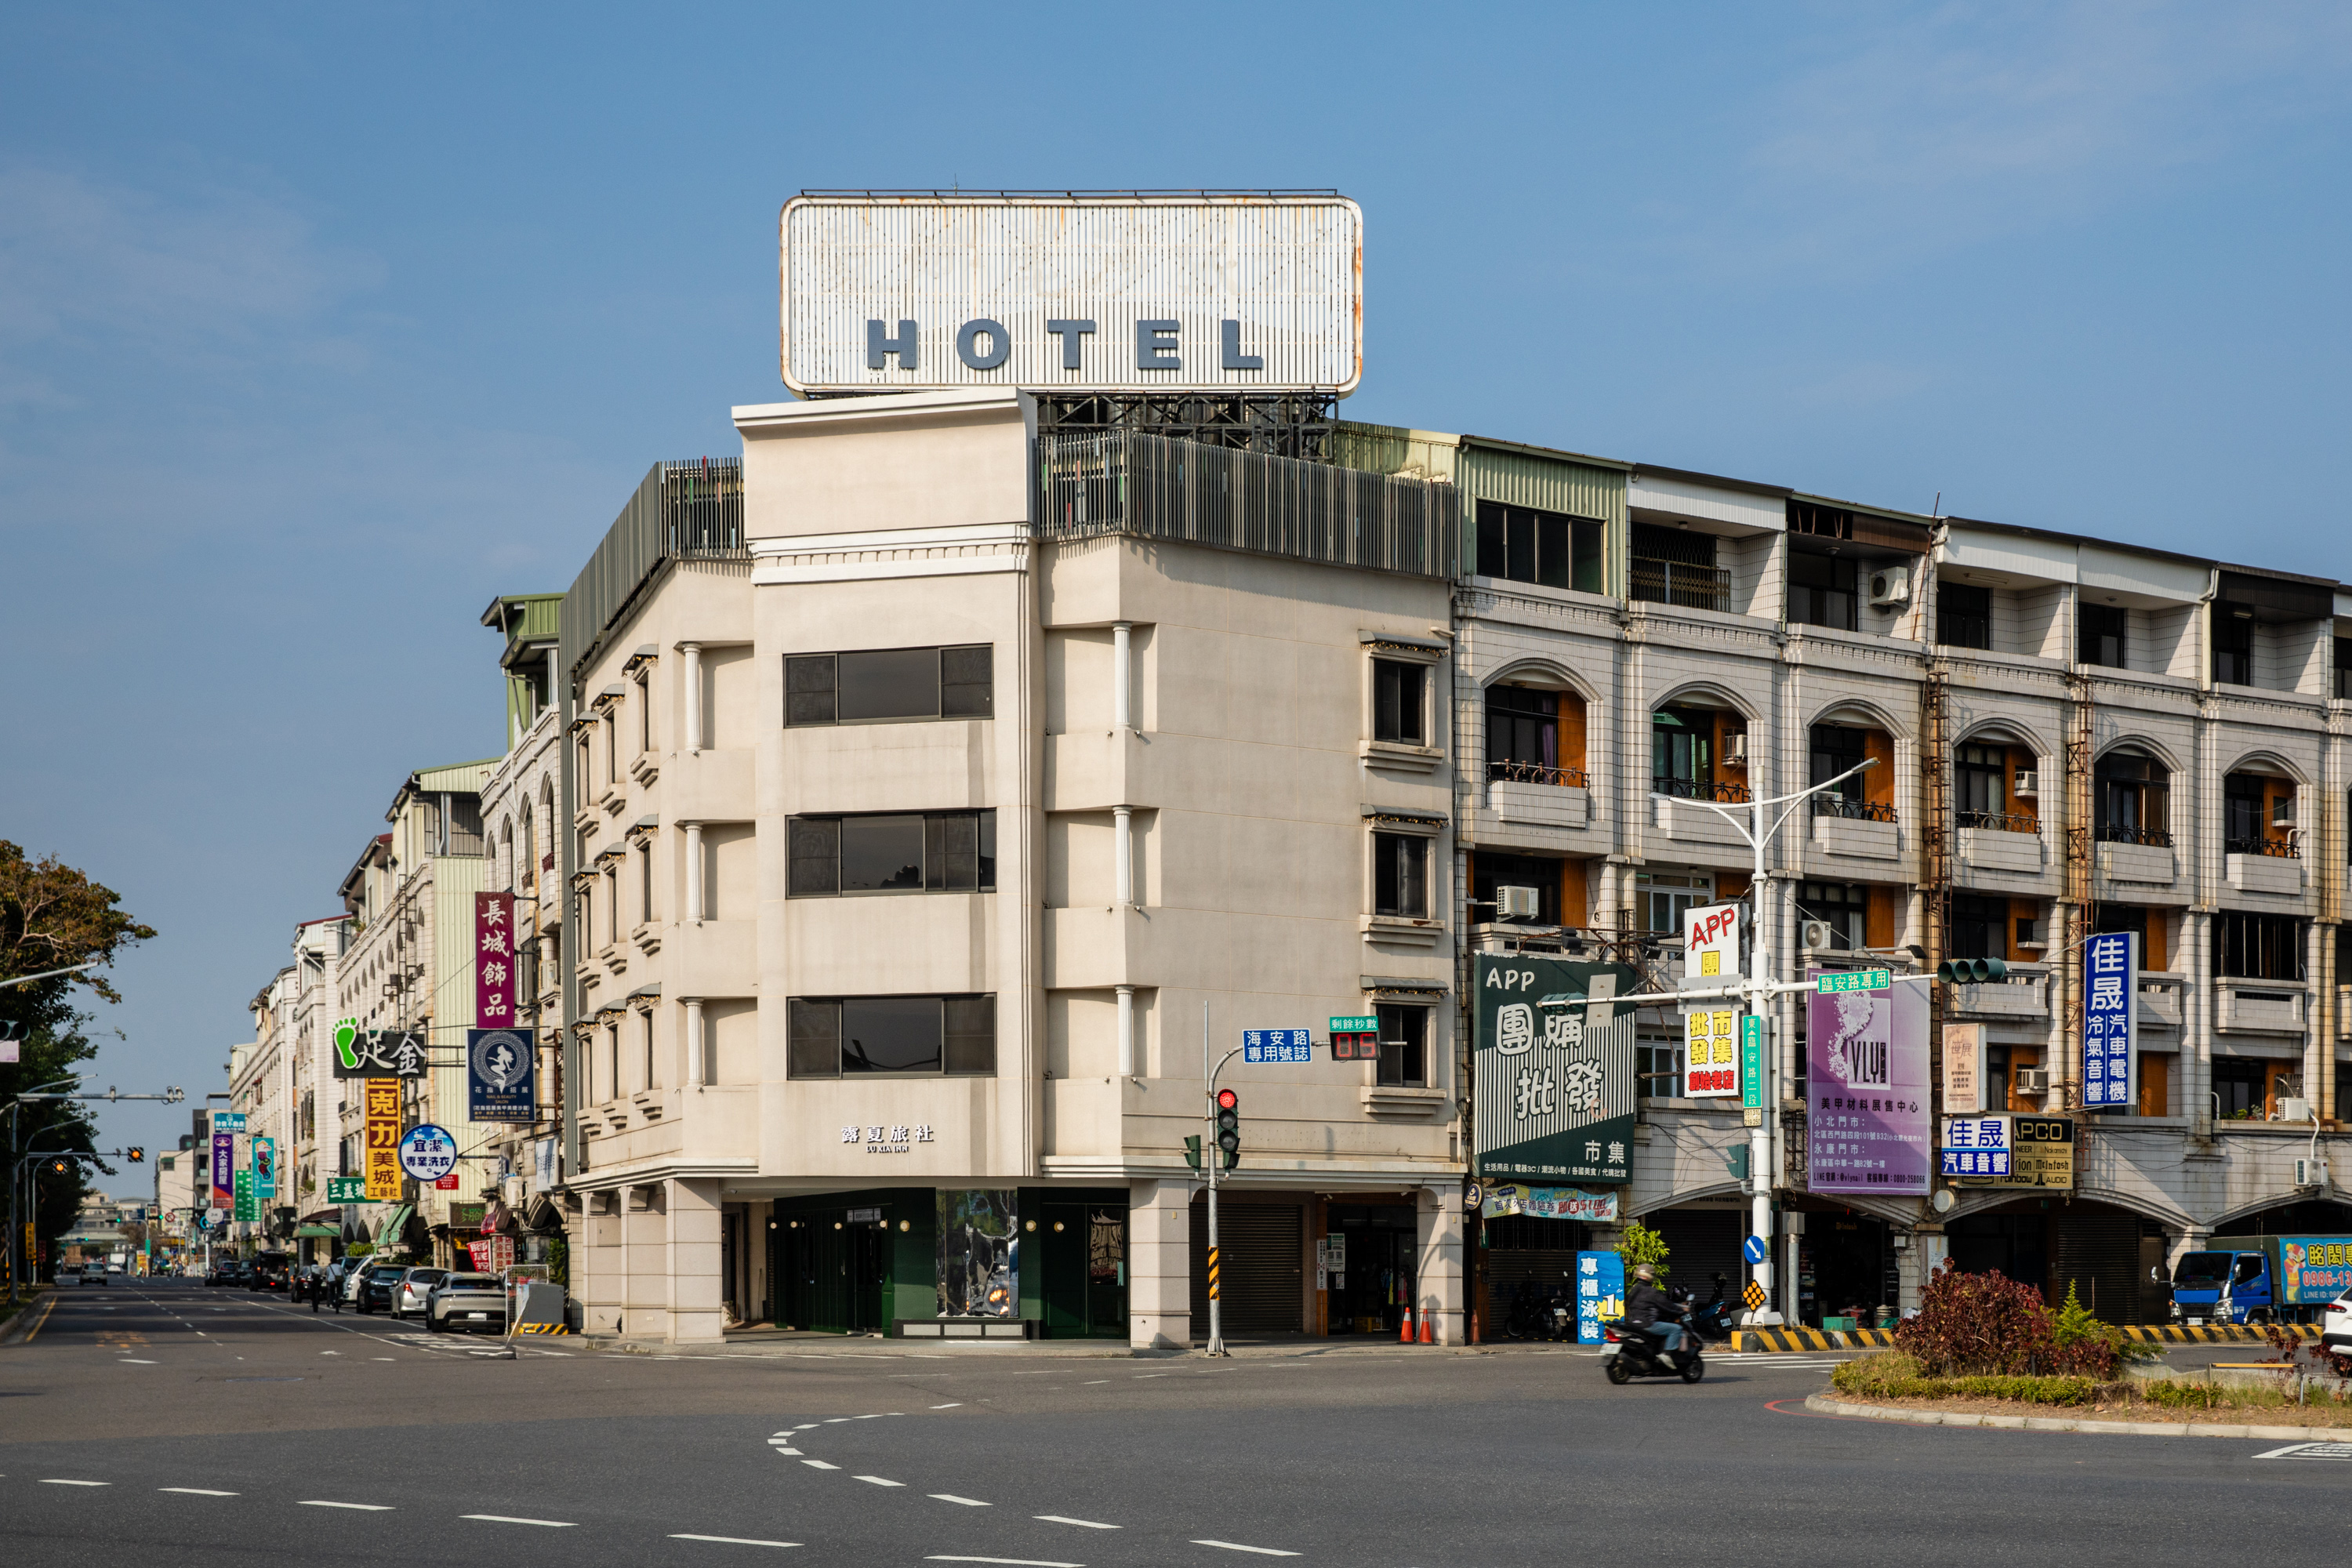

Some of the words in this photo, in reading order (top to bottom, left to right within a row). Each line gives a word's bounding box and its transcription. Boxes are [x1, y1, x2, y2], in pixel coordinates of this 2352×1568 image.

[866, 319, 1263, 370] HOTEL
[1692, 909, 1735, 951] APP
[481, 899, 510, 1018] 長城飾品
[1486, 967, 1535, 992] APP
[1821, 971, 1886, 992] 臨安路專用
[2092, 938, 2125, 1011] 佳晟
[1331, 1018, 1377, 1029] 剩餘秒數
[1748, 1018, 1756, 1029] 東
[355, 1023, 429, 1075] 足金
[1247, 1031, 1307, 1046] 海安路
[1336, 1033, 1376, 1057] 05
[1690, 1011, 1709, 1065] 批發
[1712, 1011, 1733, 1064] 市集
[1248, 1047, 1308, 1062] 專用號誌
[1851, 1040, 1878, 1083] VLY
[2086, 1014, 2103, 1102] 冷氣音響
[2109, 1014, 2127, 1101] 汽車電機
[1689, 1069, 1735, 1091] 創始老店
[1748, 1036, 1757, 1105] 臨安路二段
[1516, 1058, 1603, 1120] 批發
[369, 1079, 397, 1147] 克力
[1821, 1098, 1918, 1112] 美甲材料展售中心
[413, 1139, 443, 1152] 宜潔
[841, 1124, 934, 1143] 露夏旅社
[1947, 1120, 2003, 1147] 佳晟
[406, 1156, 449, 1167] 專業洗衣
[1585, 1140, 1624, 1163] 市集
[2044, 1145, 2067, 1154] Nakamichi
[218, 1149, 228, 1185] 大家房屋
[373, 1151, 394, 1185] 美城
[1484, 1163, 1509, 1172] 生活用品
[1514, 1164, 1537, 1174] 電器3C
[1541, 1165, 1566, 1174] 潮流小物
[1571, 1167, 1596, 1176] 各國美食
[1944, 1152, 2008, 1173] 汽車音響
[2035, 1159, 2068, 1171] McIntosh
[370, 1187, 397, 1197] 工藝社
[470, 1241, 489, 1272] 腳底按
[2303, 1271, 2352, 1287] 0986-13
[1581, 1257, 1599, 1339] 專櫃泳裝
